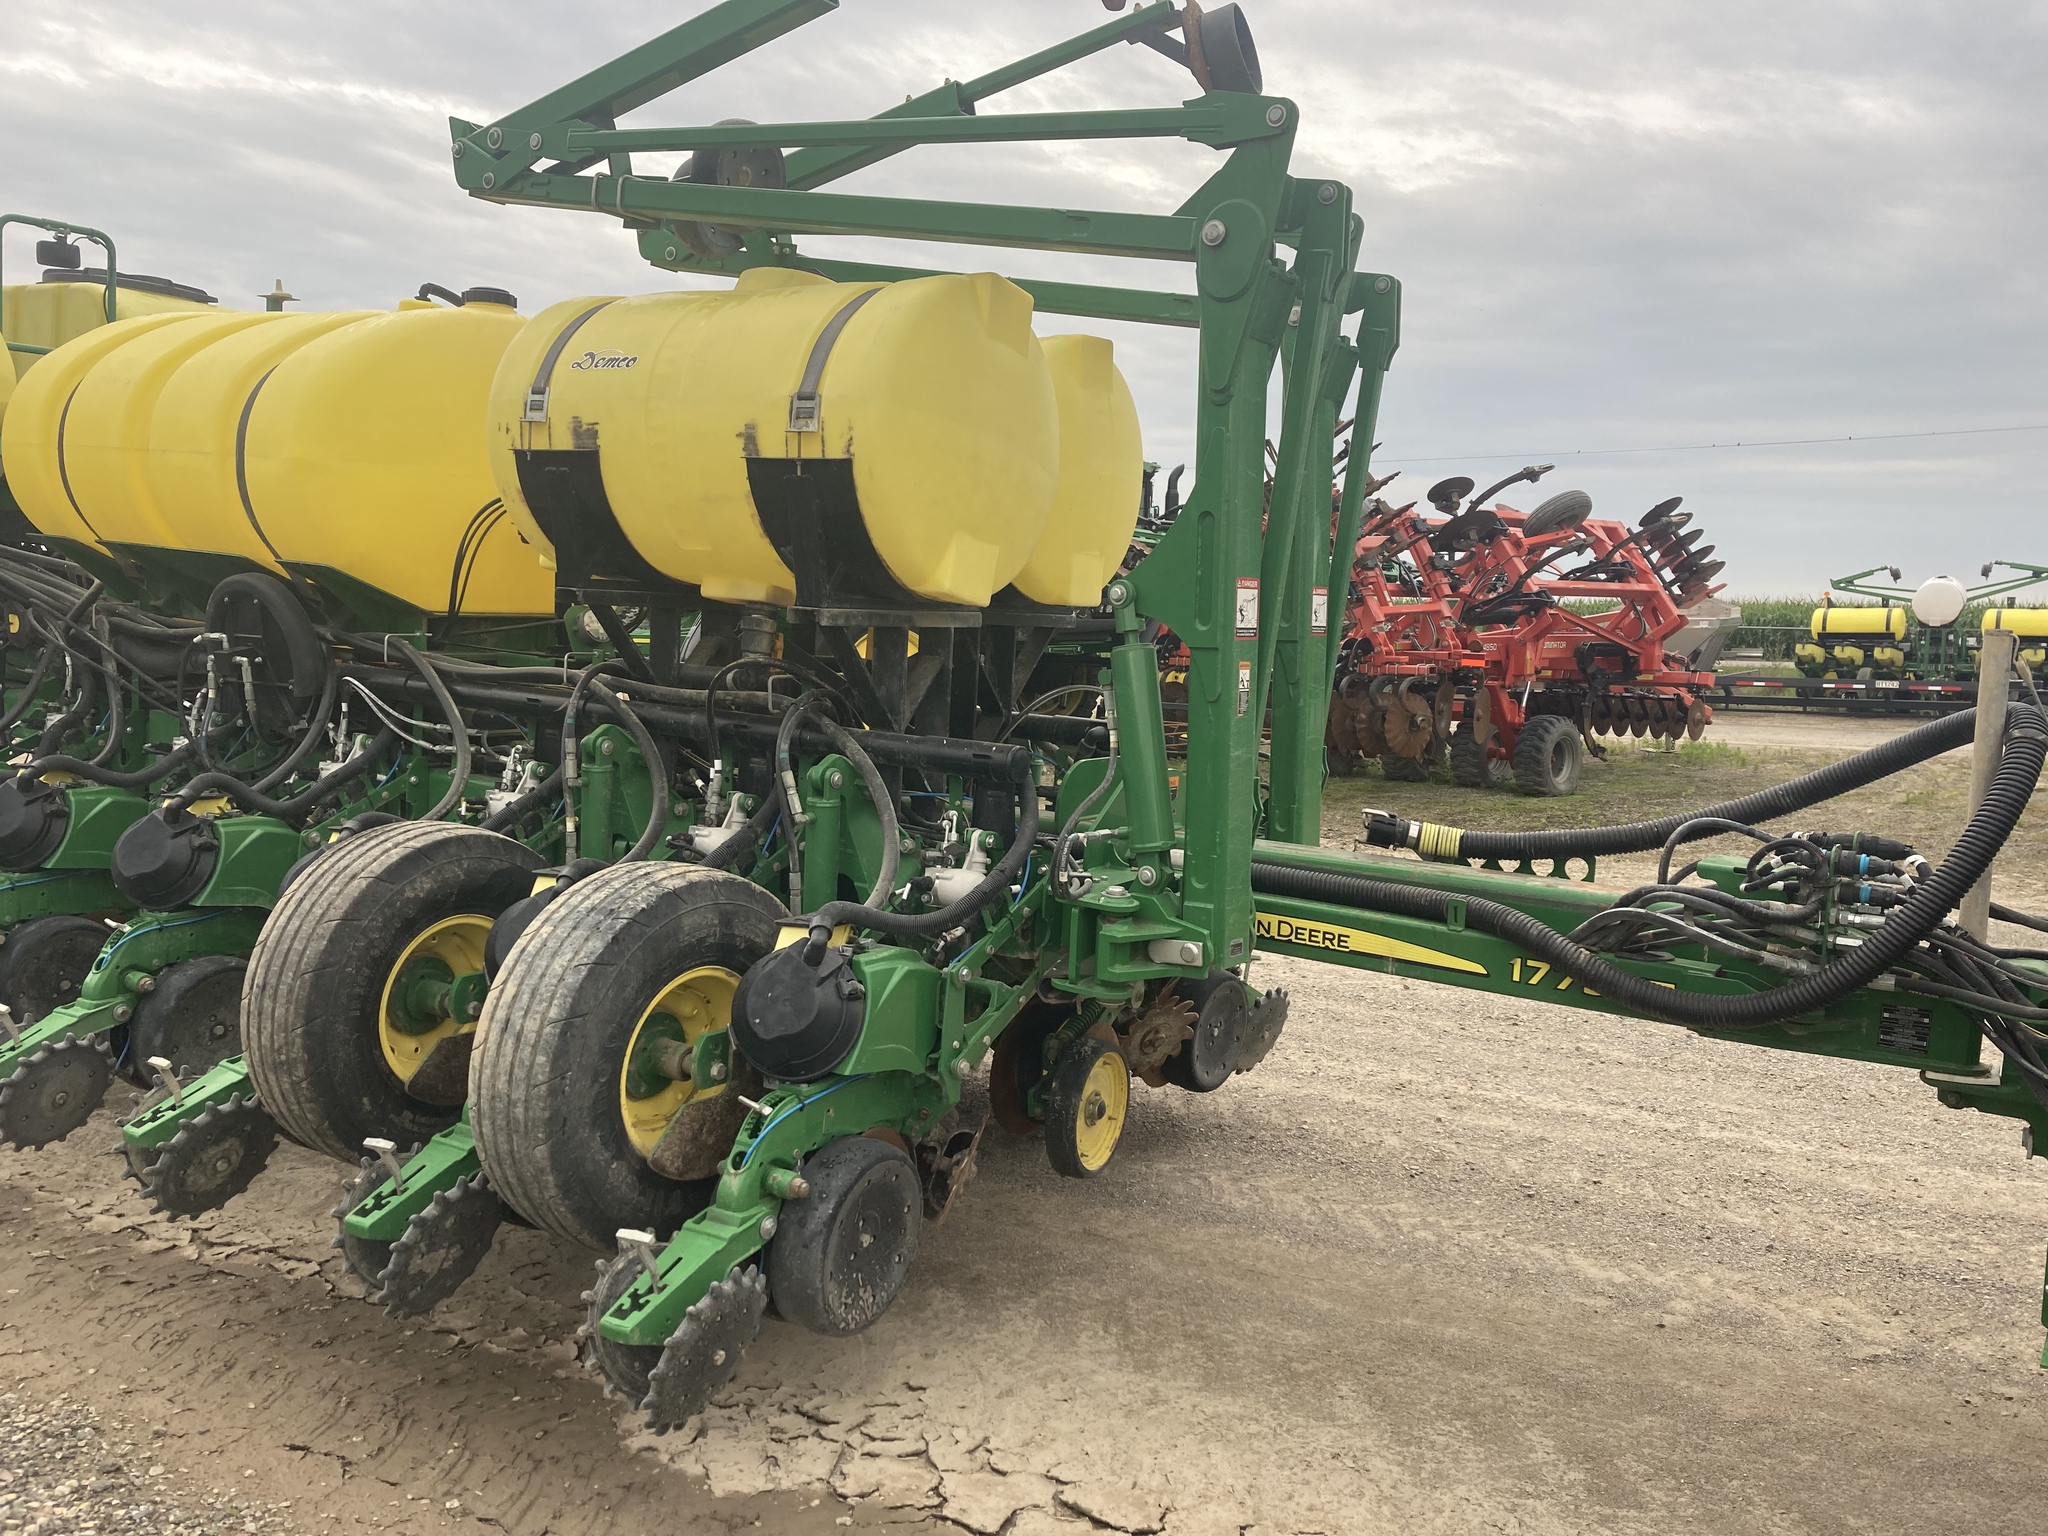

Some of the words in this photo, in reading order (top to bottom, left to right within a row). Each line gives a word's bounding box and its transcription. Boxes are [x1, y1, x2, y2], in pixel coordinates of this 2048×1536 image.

[571, 351, 639, 371] Demco
[1276, 919, 1351, 950] DEERE
[1509, 956, 1602, 997] 17
